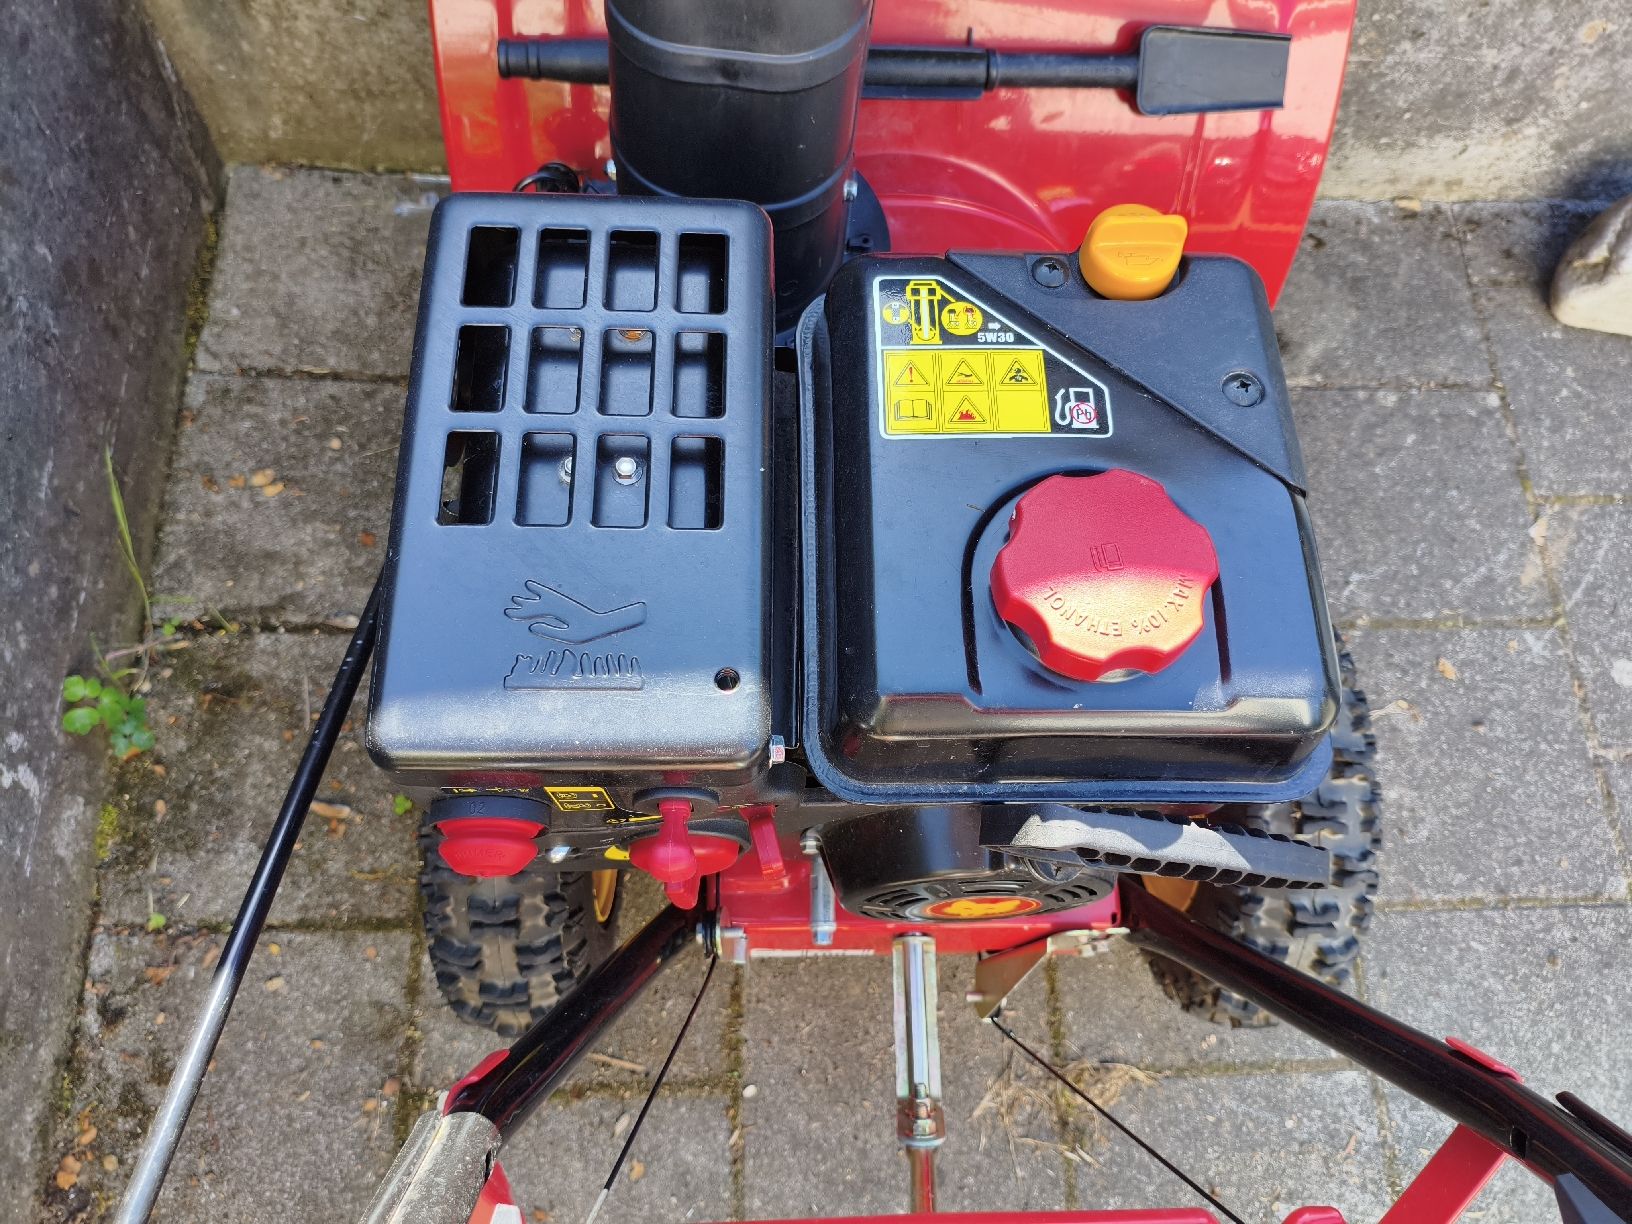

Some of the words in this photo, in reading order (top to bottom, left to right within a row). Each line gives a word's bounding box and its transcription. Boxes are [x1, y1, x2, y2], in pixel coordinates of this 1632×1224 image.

[977, 332, 1014, 343] 5W30
[1043, 586, 1123, 637] ETHANOL
[1131, 609, 1168, 635] 10%
